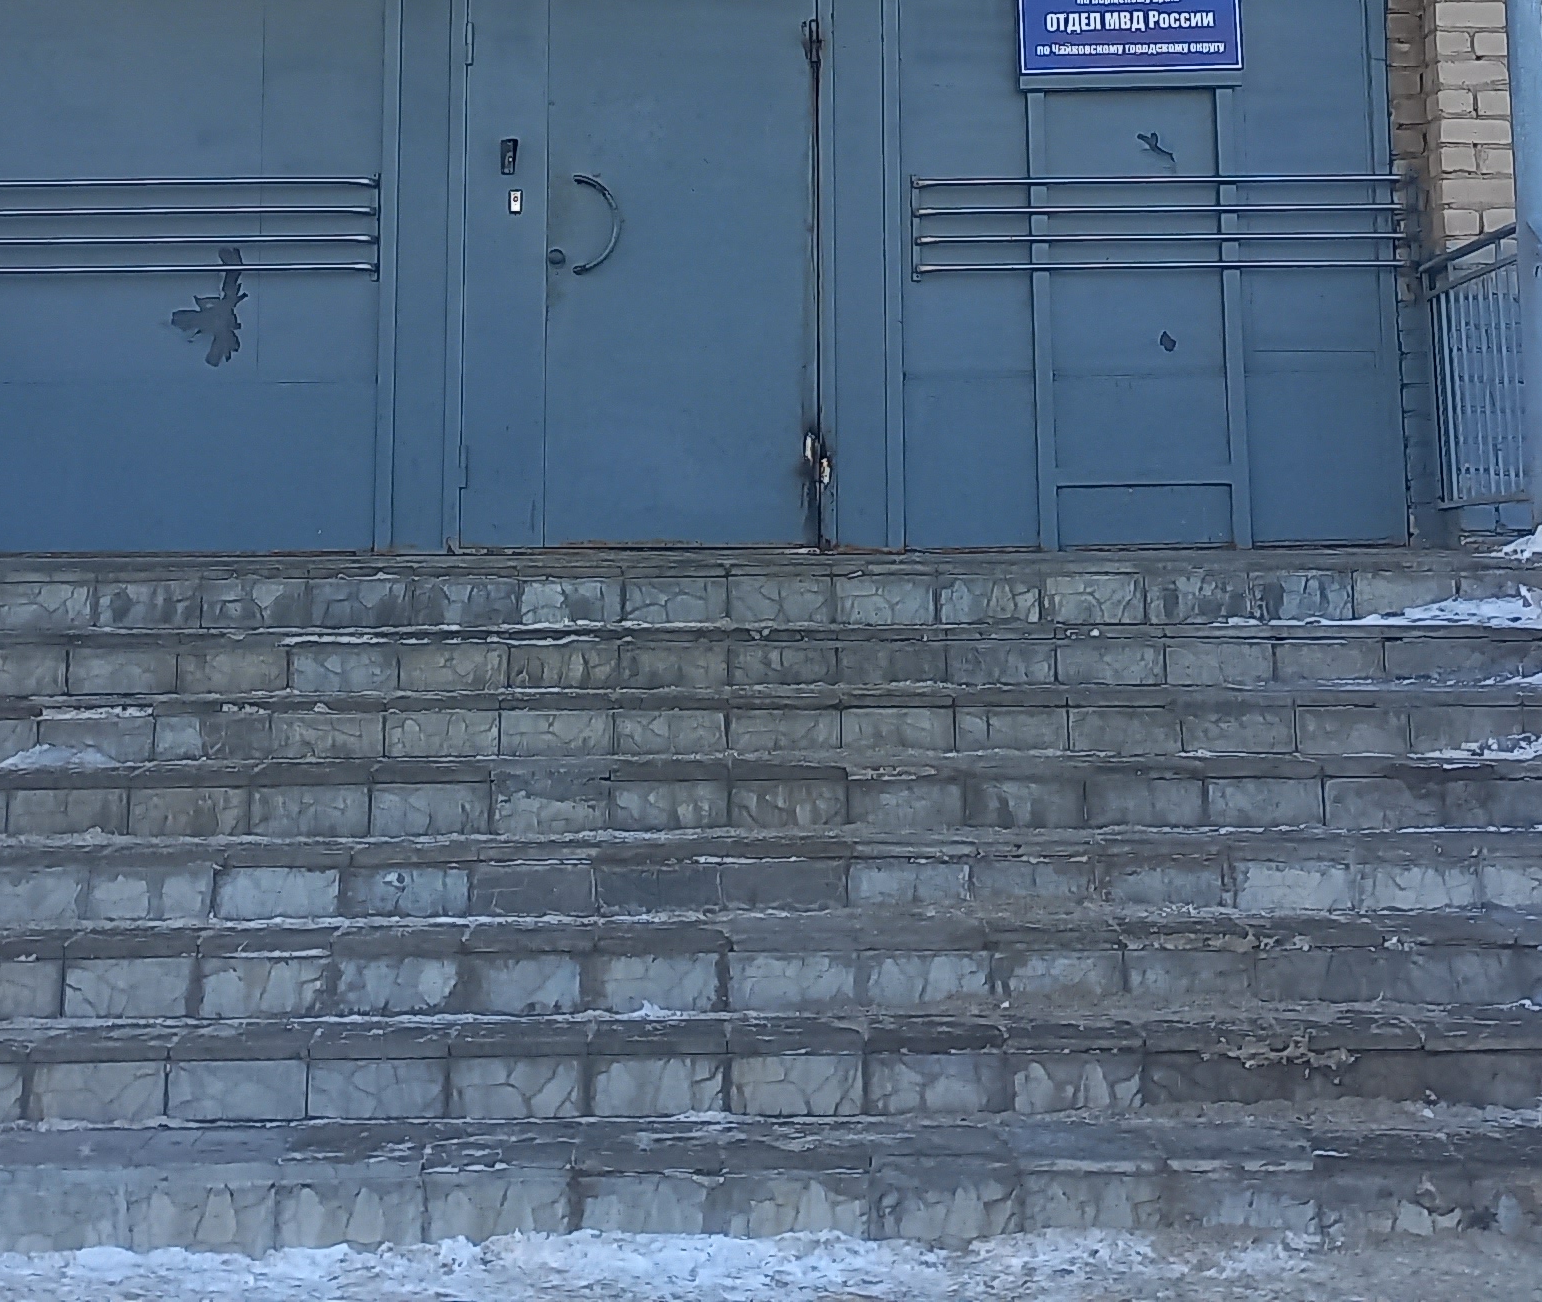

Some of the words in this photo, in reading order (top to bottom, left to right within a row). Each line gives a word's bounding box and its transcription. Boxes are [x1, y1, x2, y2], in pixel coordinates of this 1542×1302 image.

[1046, 11, 1102, 34] ОТДЕЛ
[1105, 10, 1146, 32] МВД
[1149, 10, 1215, 29] России
[1036, 44, 1051, 56] по
[1052, 42, 1124, 56] Чайковскому
[1125, 42, 1189, 56] городскому
[1190, 41, 1225, 54] округу
